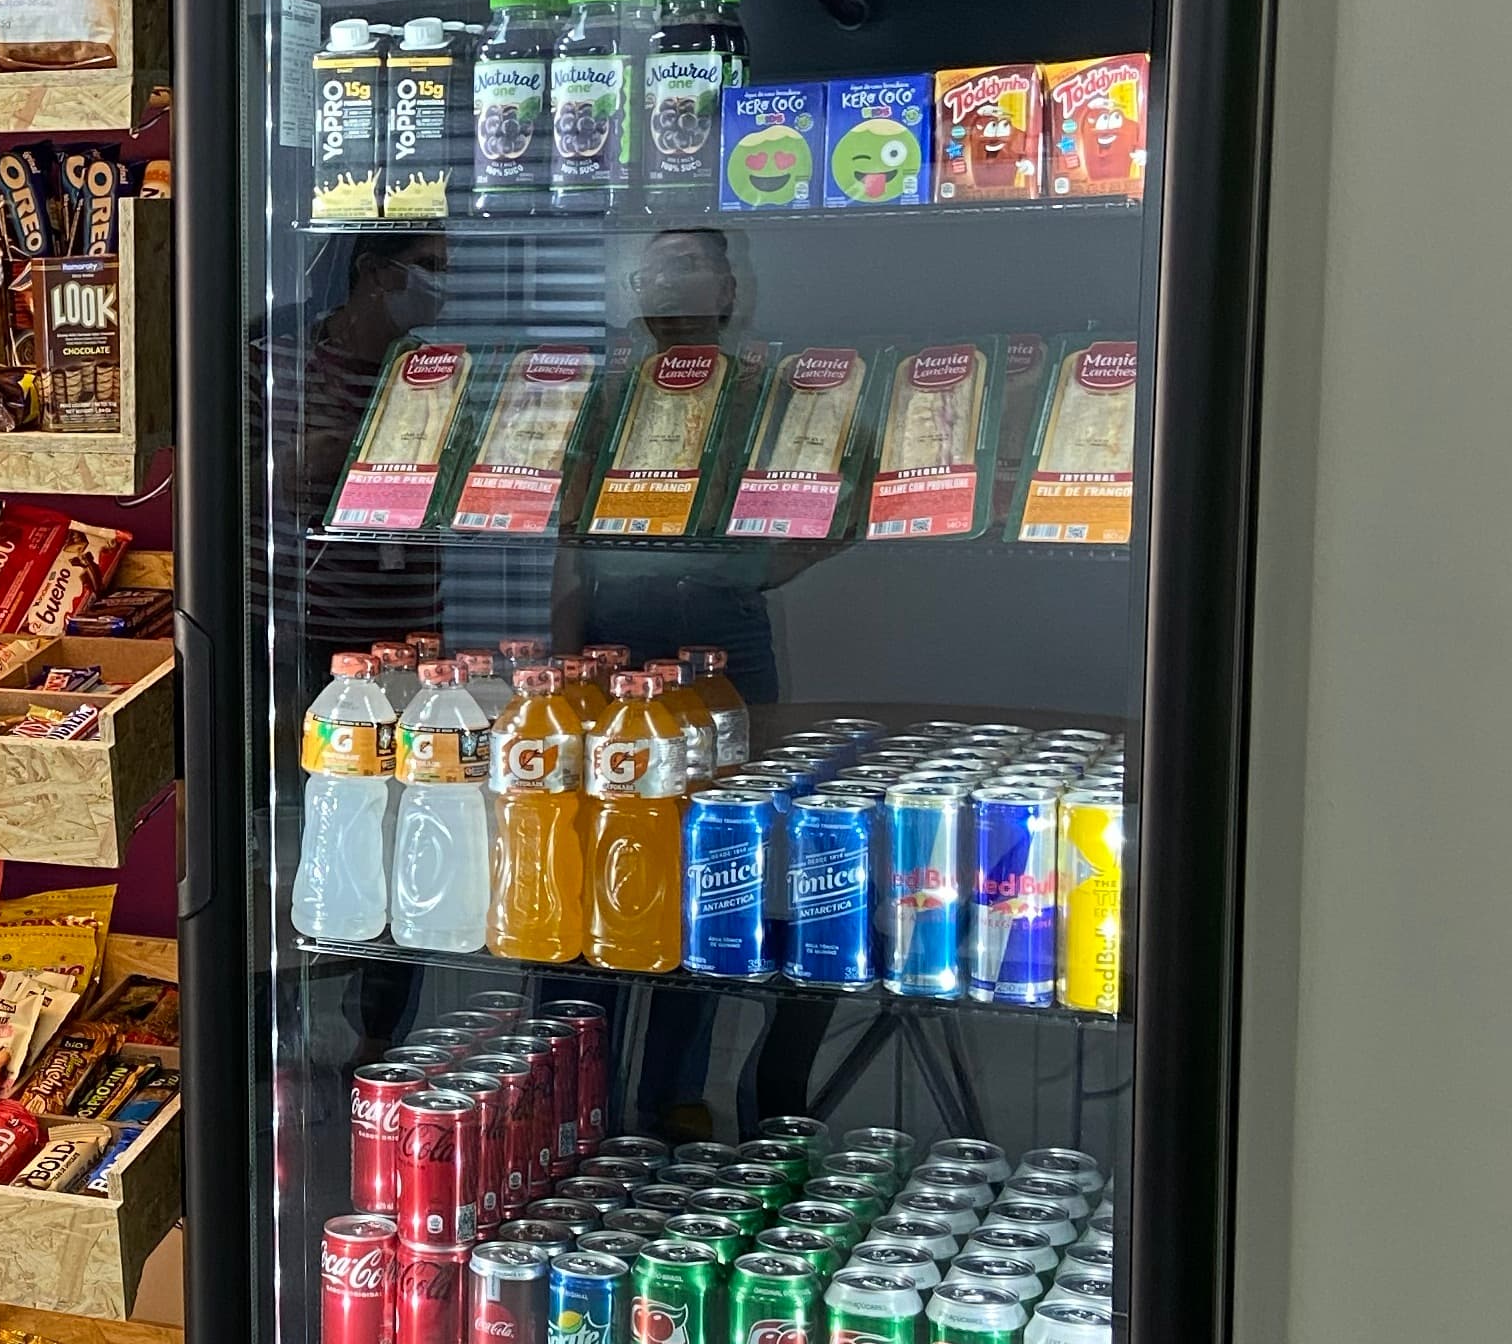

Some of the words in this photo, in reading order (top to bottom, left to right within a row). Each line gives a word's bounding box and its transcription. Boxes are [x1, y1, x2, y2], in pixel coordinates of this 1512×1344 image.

[474, 67, 541, 93] Natural
[554, 62, 617, 89] Natural
[646, 61, 718, 87] Natural
[344, 81, 371, 99] 15g
[418, 80, 444, 98] 15g
[1053, 64, 1138, 119] Toddynho
[944, 73, 1029, 124] Toddynho
[85, 160, 114, 256] OREO
[50, 279, 118, 331] LOOK
[62, 344, 111, 356] CHOCOLATE
[410, 352, 458, 367] Mania
[527, 352, 581, 367] Mania
[661, 355, 713, 370] Mania
[796, 357, 849, 371] Mania
[915, 353, 969, 369] Mania
[407, 362, 454, 376] Lanches
[525, 361, 576, 376] Lanches
[659, 366, 709, 380] Lanches
[793, 367, 846, 381] Lanches
[912, 364, 967, 379] Lanches
[630, 470, 679, 479] INTEGRAL
[629, 482, 646, 492] DE
[648, 482, 692, 493] FRANGO
[781, 483, 800, 493] DE
[43, 567, 71, 626] bueno
[702, 893, 755, 913] ANTARCTICA
[799, 899, 852, 918] ANTARCTICA
[31, 1142, 75, 1182] BOLD
